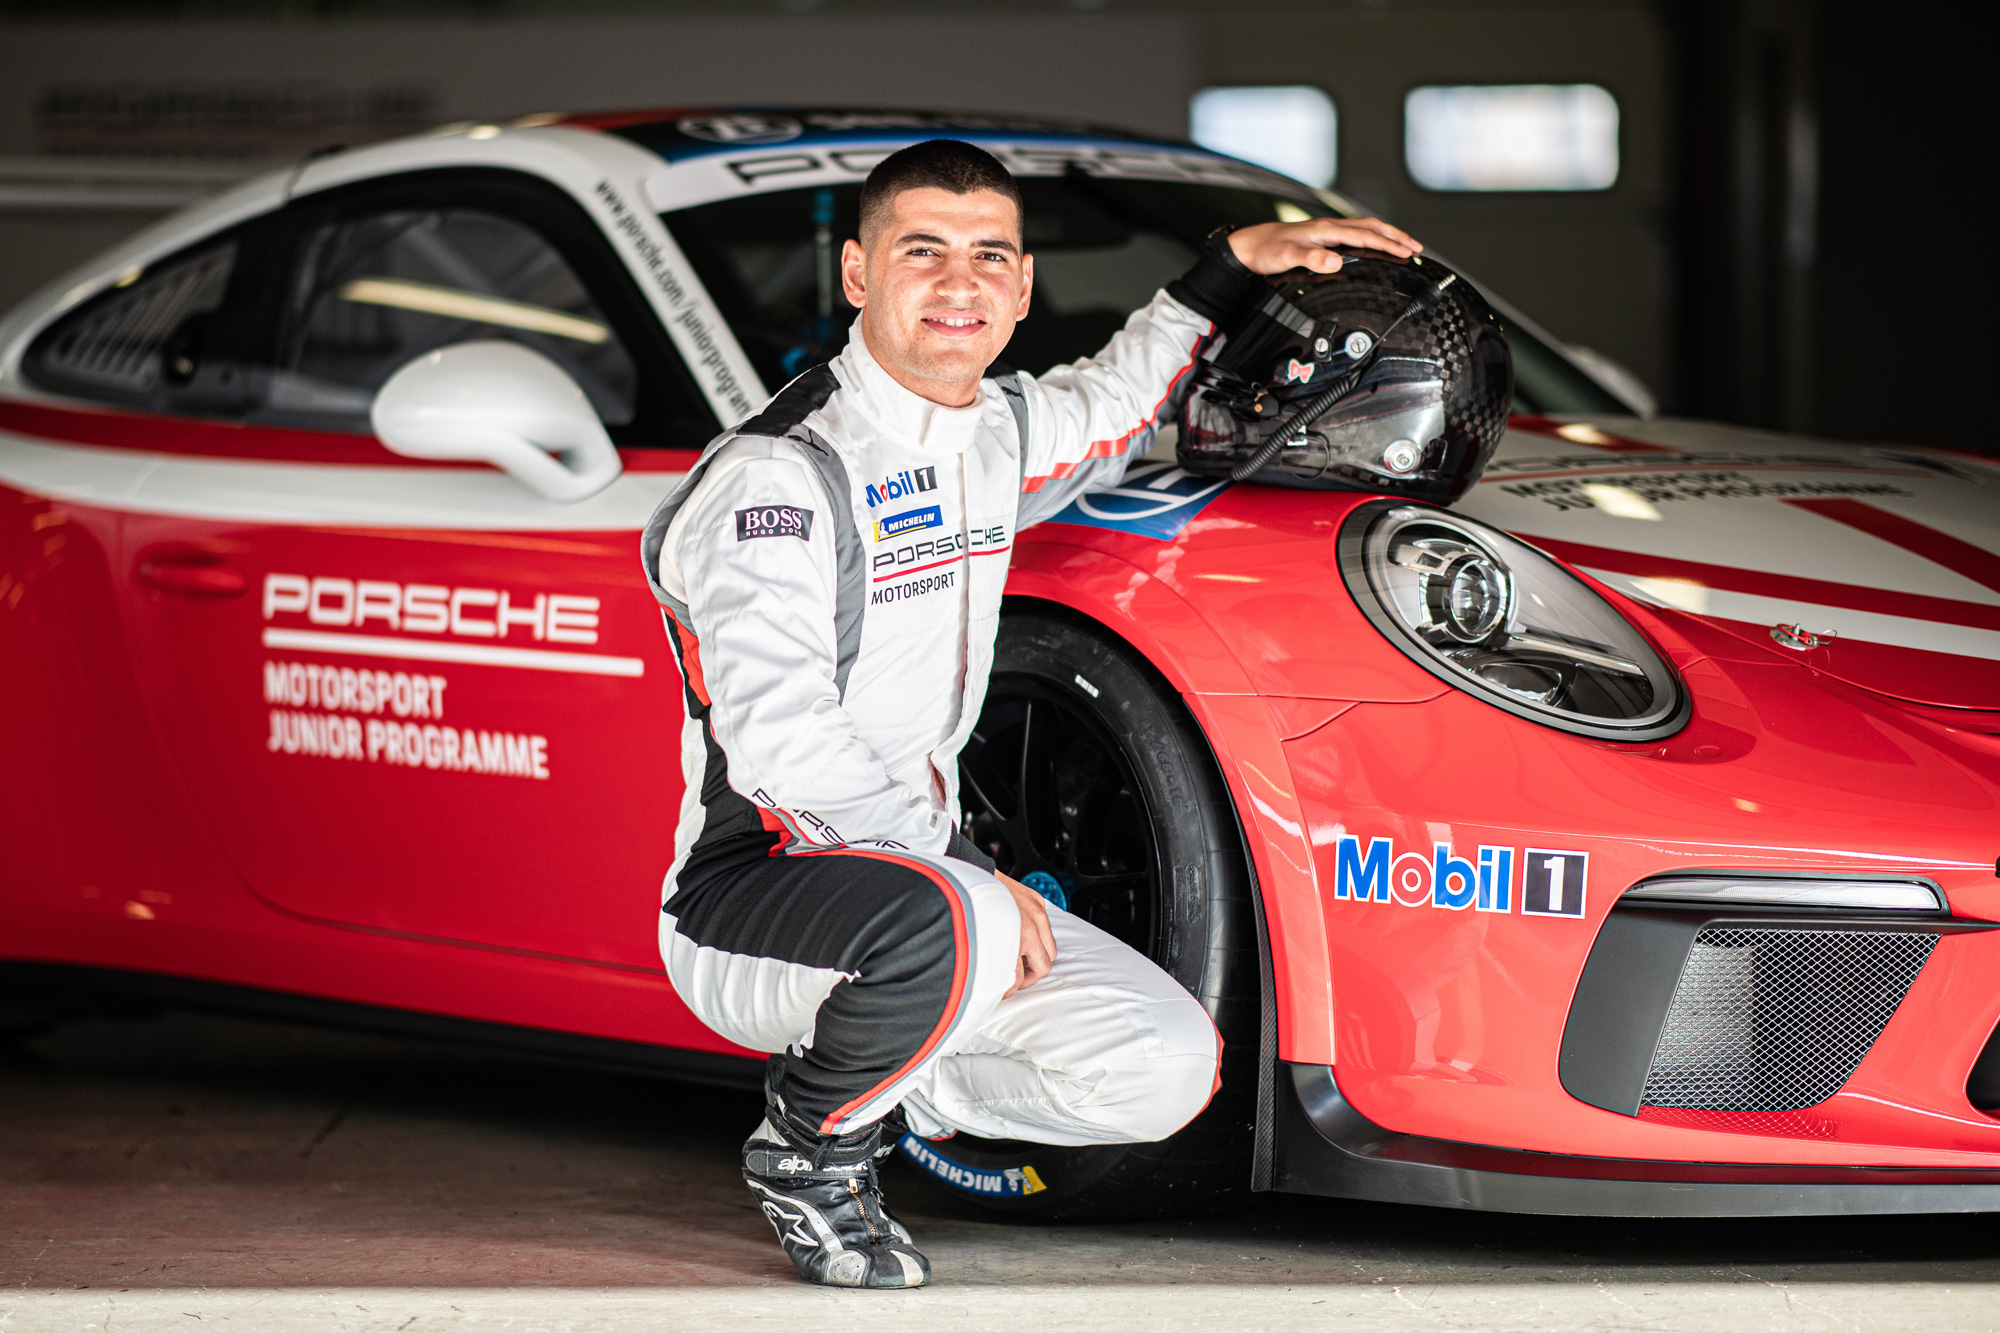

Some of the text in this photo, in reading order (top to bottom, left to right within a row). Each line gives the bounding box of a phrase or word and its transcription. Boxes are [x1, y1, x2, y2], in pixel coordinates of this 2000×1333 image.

[865, 470, 915, 508] Mobil
[745, 508, 802, 530] BOSS
[745, 527, 802, 537] HUGO BOSS
[888, 512, 935, 532] MICHELIN
[873, 525, 1006, 571] PORSCHE
[262, 572, 600, 645] PORSCHE
[871, 571, 955, 605] MOTORSPORT
[263, 660, 447, 720] MOTORSPORT
[267, 709, 550, 780] JUNIOR PROGRAMME
[1334, 833, 1515, 915] Mobil
[903, 1135, 1002, 1193] MICHELIN
